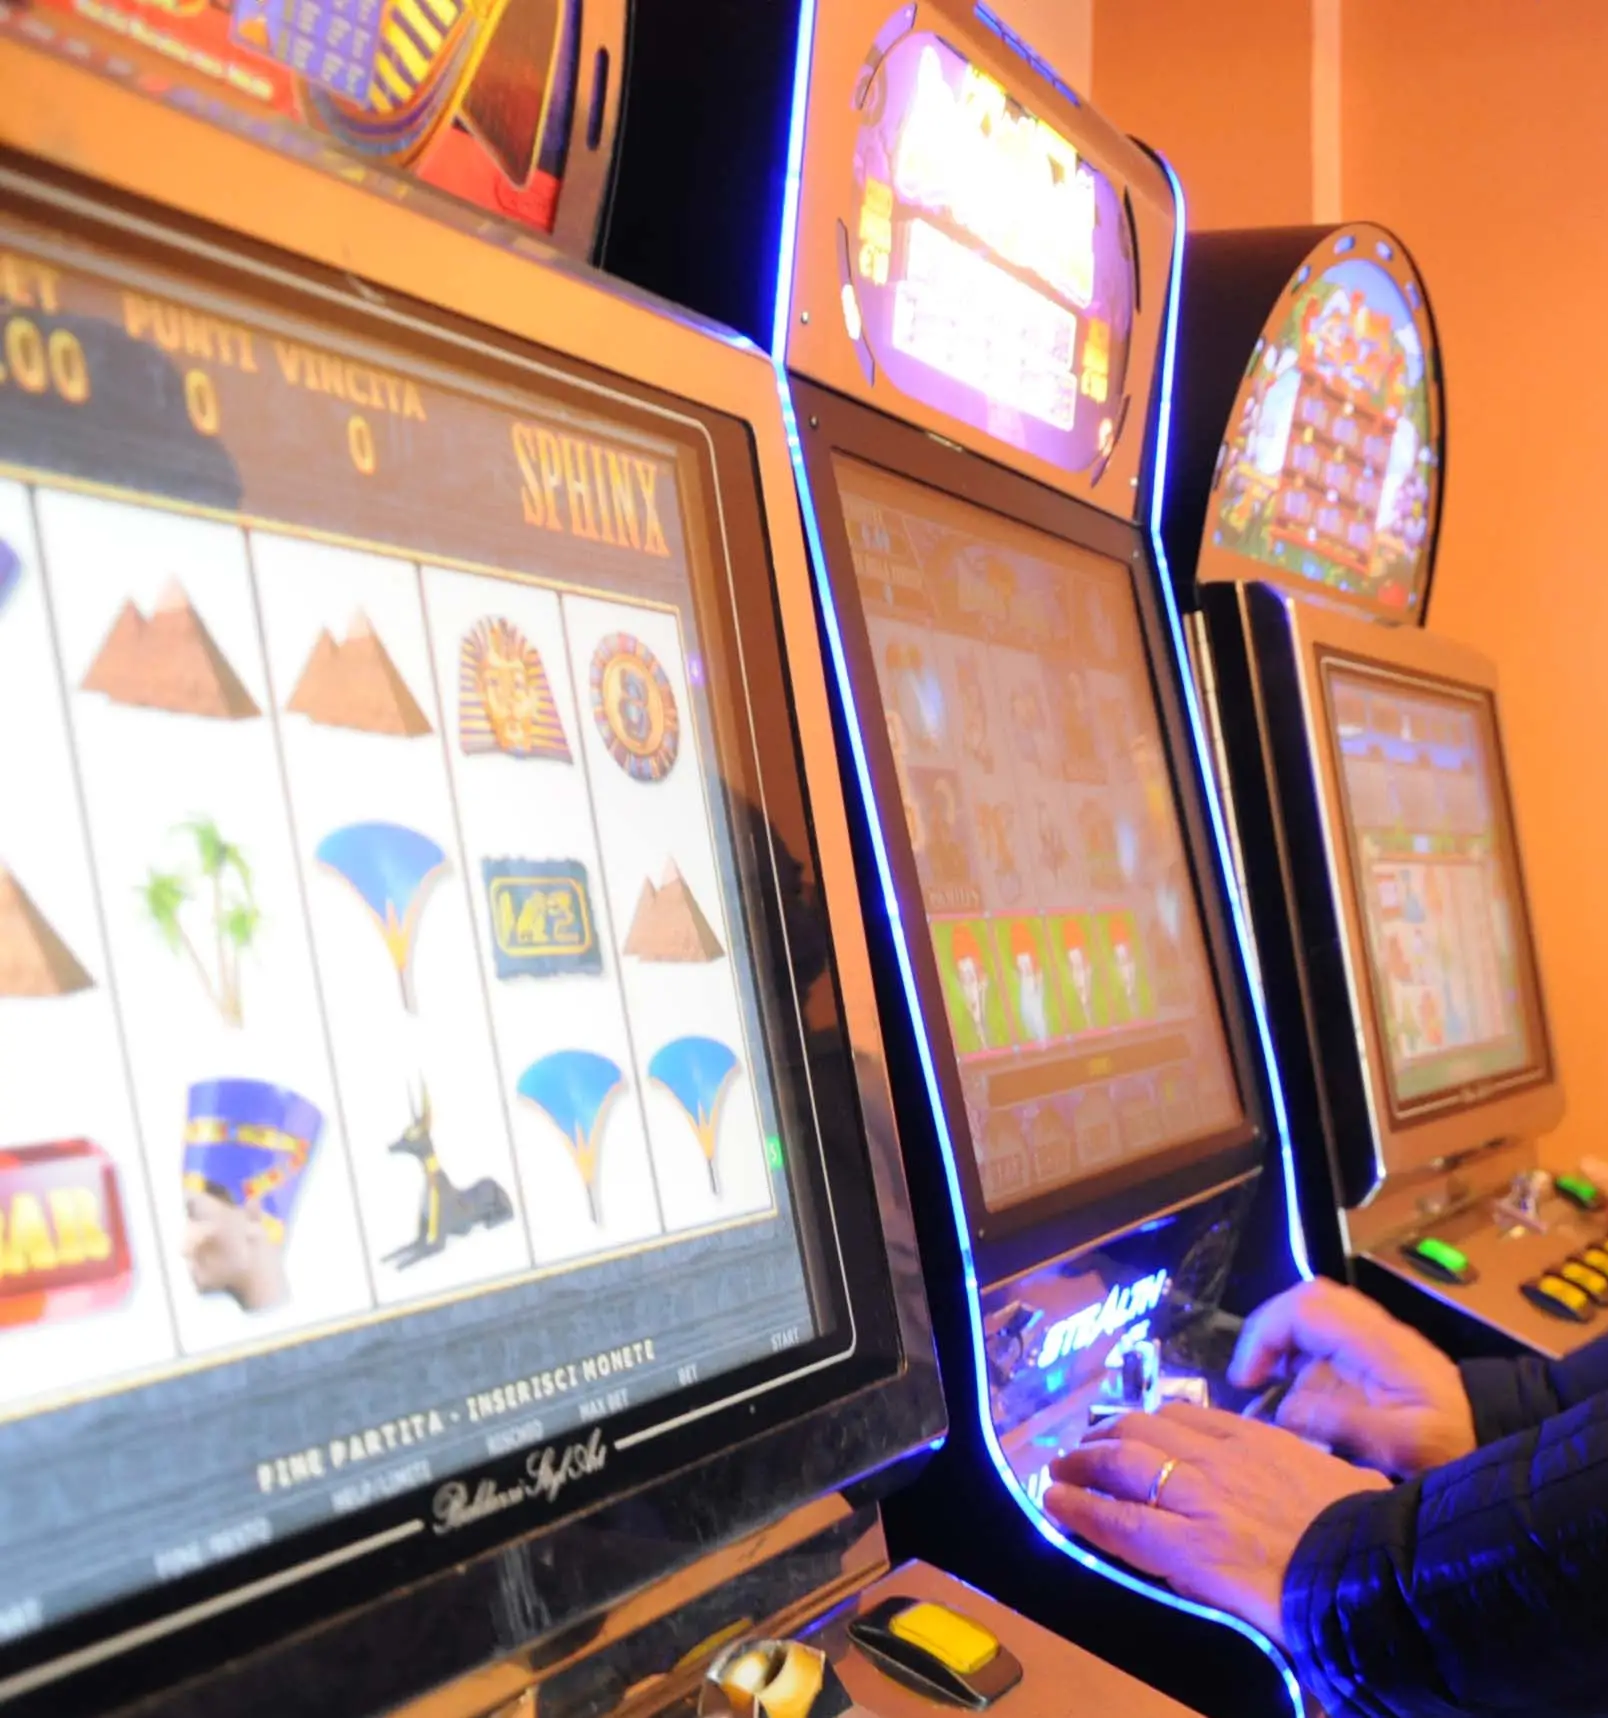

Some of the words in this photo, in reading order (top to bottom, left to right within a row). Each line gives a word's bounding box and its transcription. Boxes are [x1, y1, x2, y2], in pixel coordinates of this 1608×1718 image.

[0, 252, 60, 314] ET
[122, 290, 259, 373] PUNTI
[184, 368, 220, 435] 0
[275, 340, 428, 422] VINCITA
[346, 415, 376, 476] 0
[512, 421, 670, 558] SPHINX
[0, 1187, 113, 1277] AR
[771, 1327, 800, 1353] START
[329, 1409, 445, 1469] PARTITA
[466, 1366, 577, 1422] INSERISCI
[582, 1339, 656, 1384] MONETE
[677, 1363, 699, 1386] BET
[578, 1396, 606, 1423] MAX
